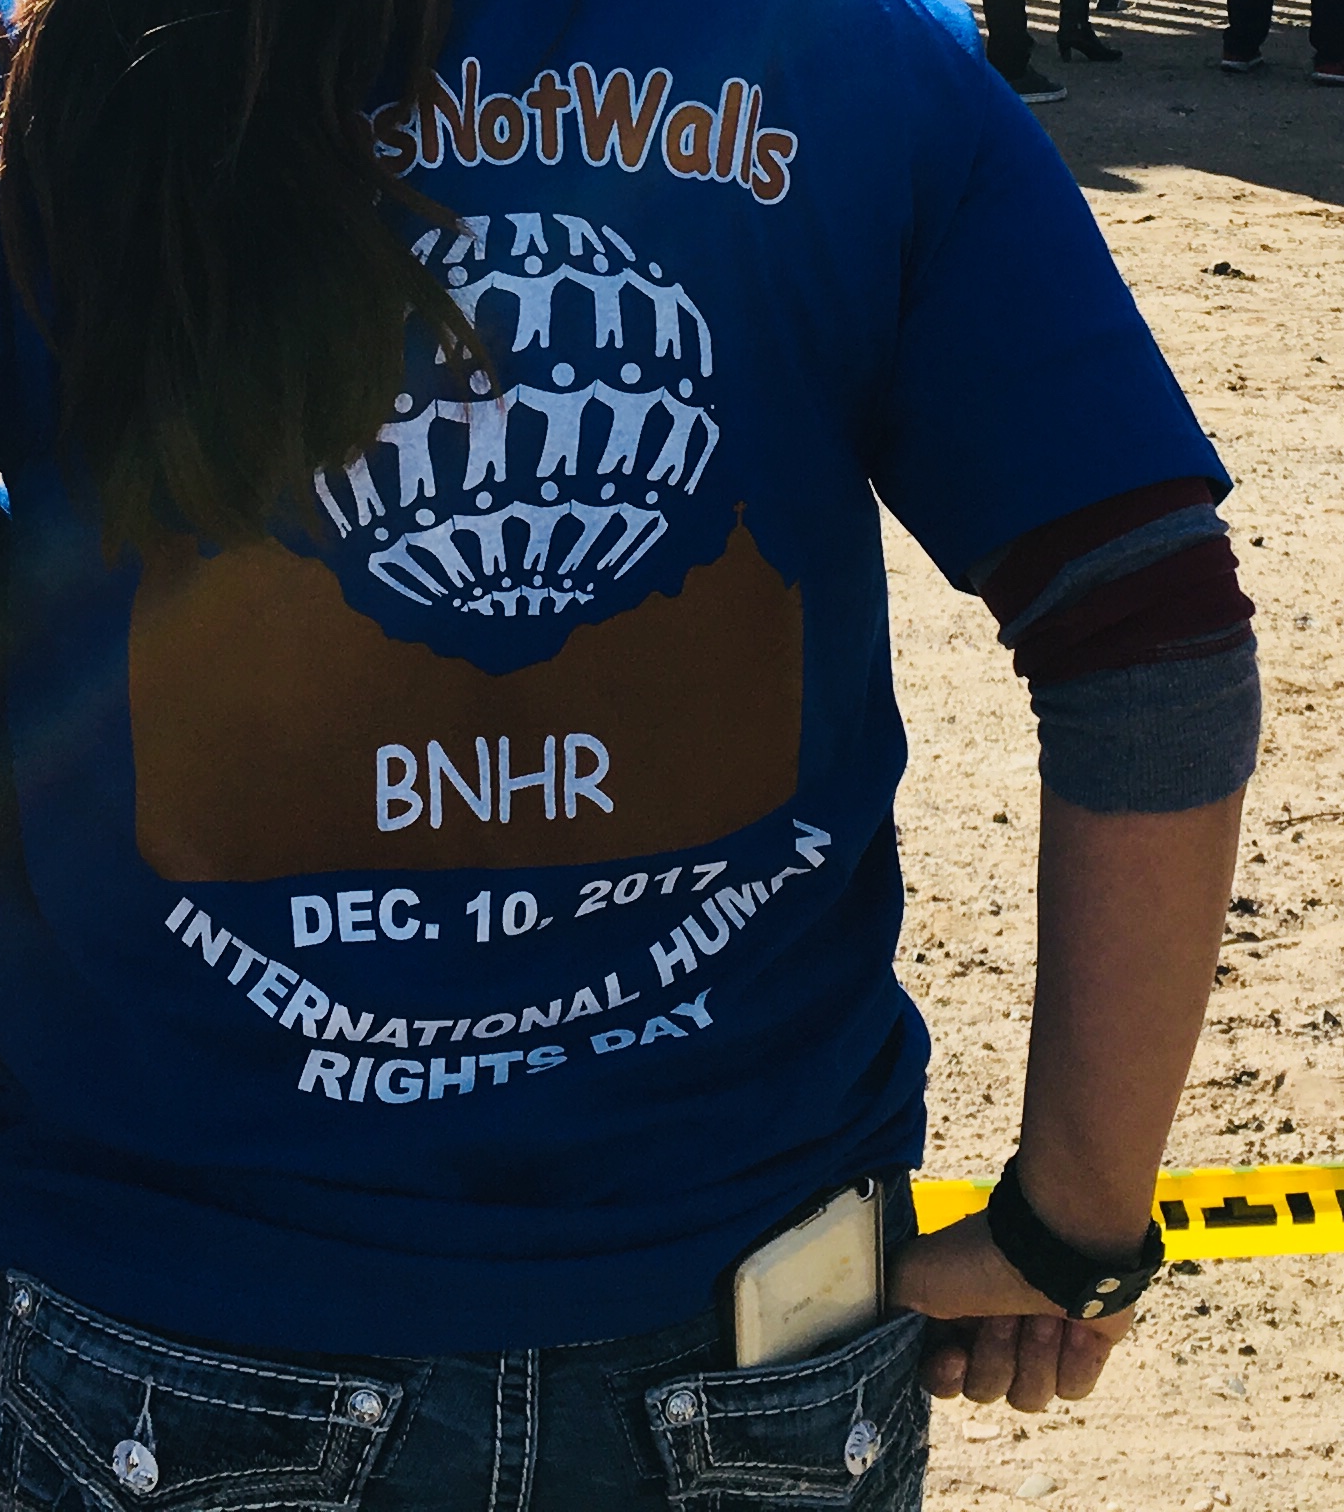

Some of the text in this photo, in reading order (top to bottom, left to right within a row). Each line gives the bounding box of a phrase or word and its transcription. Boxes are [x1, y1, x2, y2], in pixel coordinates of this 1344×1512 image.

[362, 56, 798, 205] sNotWalls
[375, 733, 614, 832] BNHR
[291, 860, 728, 947] DEC. 10, 2017
[164, 897, 641, 1048] INTERNATIONAL
[297, 987, 713, 1104] RIGHTS DAY
